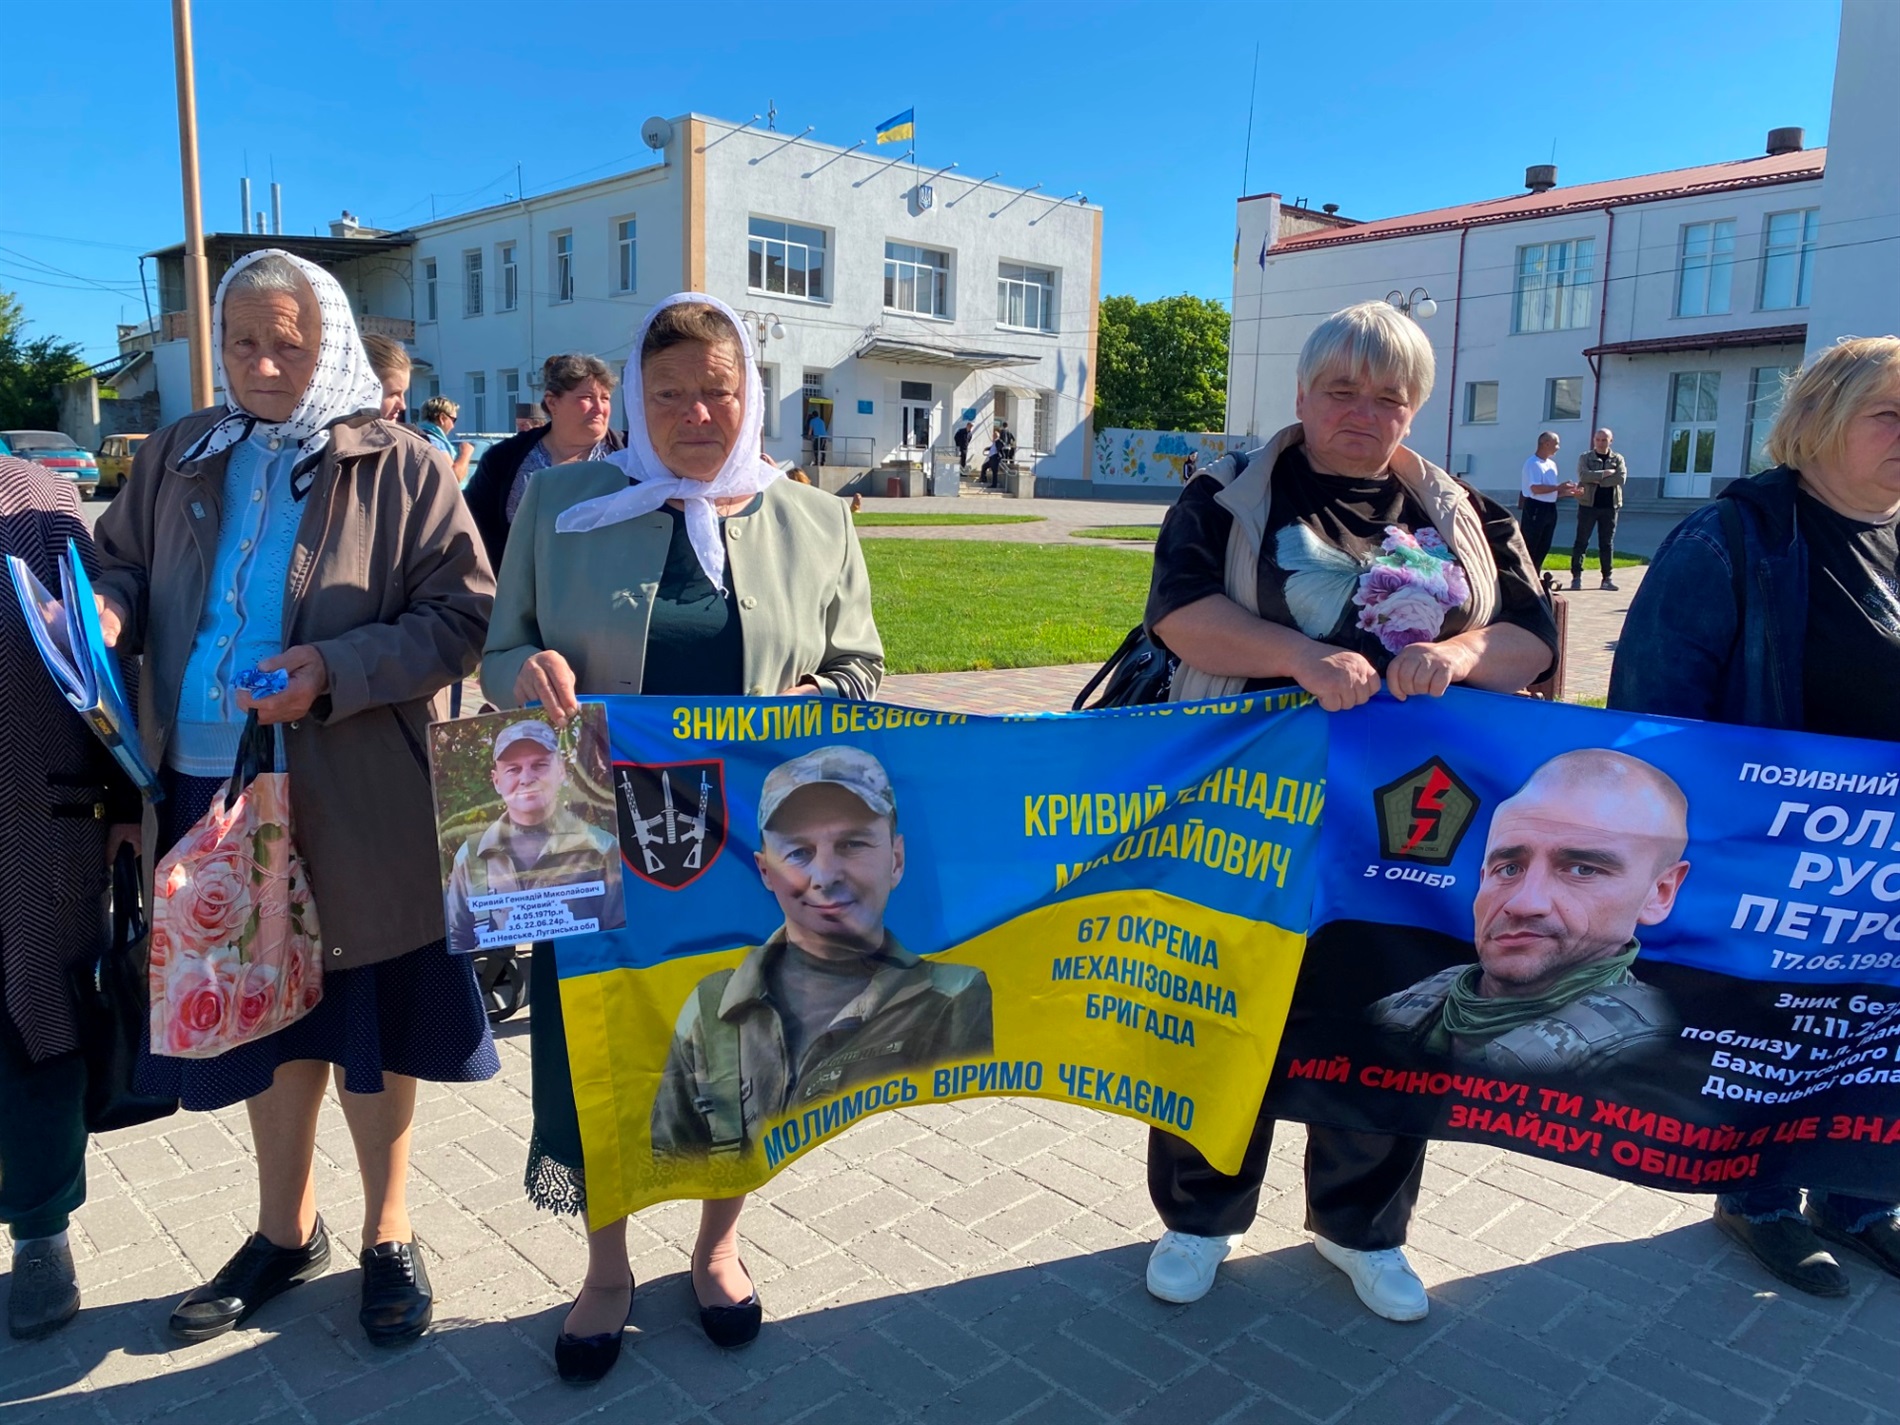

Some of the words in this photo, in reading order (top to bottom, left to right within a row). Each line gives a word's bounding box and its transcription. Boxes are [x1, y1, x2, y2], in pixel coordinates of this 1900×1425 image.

[673, 700, 821, 741] ЗНИКЛИЙ
[1739, 762, 1900, 796] ПОЗИВНИЙ
[1025, 785, 1166, 836] КРИВИЙ
[1767, 801, 1900, 852] ГОЛ
[1055, 819, 1291, 889] МОЛАЙОВИЧ
[1363, 865, 1381, 878] 5
[1384, 867, 1456, 889] ОШБР
[472, 897, 504, 908] Кривий
[505, 891, 542, 904] Геннадій
[543, 886, 600, 899] Миколайович
[536, 926, 579, 937] Луганська
[580, 922, 596, 931] обл
[1077, 916, 1111, 943] 67
[1117, 915, 1219, 970] ОКРЕМА
[1052, 955, 1237, 1018] МЕХАНІЗОВАНА
[1774, 993, 1841, 1009] Зник
[1086, 993, 1195, 1047] БРИГАДА
[1680, 1026, 1801, 1061] поблизу
[1711, 1046, 1888, 1086] Бахмутського
[1287, 1055, 1351, 1083] МІЙ
[1359, 1065, 1529, 1105] СИНОЧКУ!
[1537, 1088, 1584, 1118] ТИ
[1590, 1099, 1746, 1152] ЖИВИЙ!
[1746, 1125, 1771, 1147] Я
[1773, 1116, 1821, 1144] ЦЕ
[1701, 1074, 1839, 1105] Донецької
[763, 1075, 918, 1170] МОЛИМОСЬ
[933, 1060, 1043, 1098] ВІРИМО
[1058, 1063, 1195, 1132] ЧЕКАЄМО
[1447, 1104, 1604, 1157] ЗНАЙДУ!
[1611, 1140, 1761, 1185] ОБІЦЯЮ!
